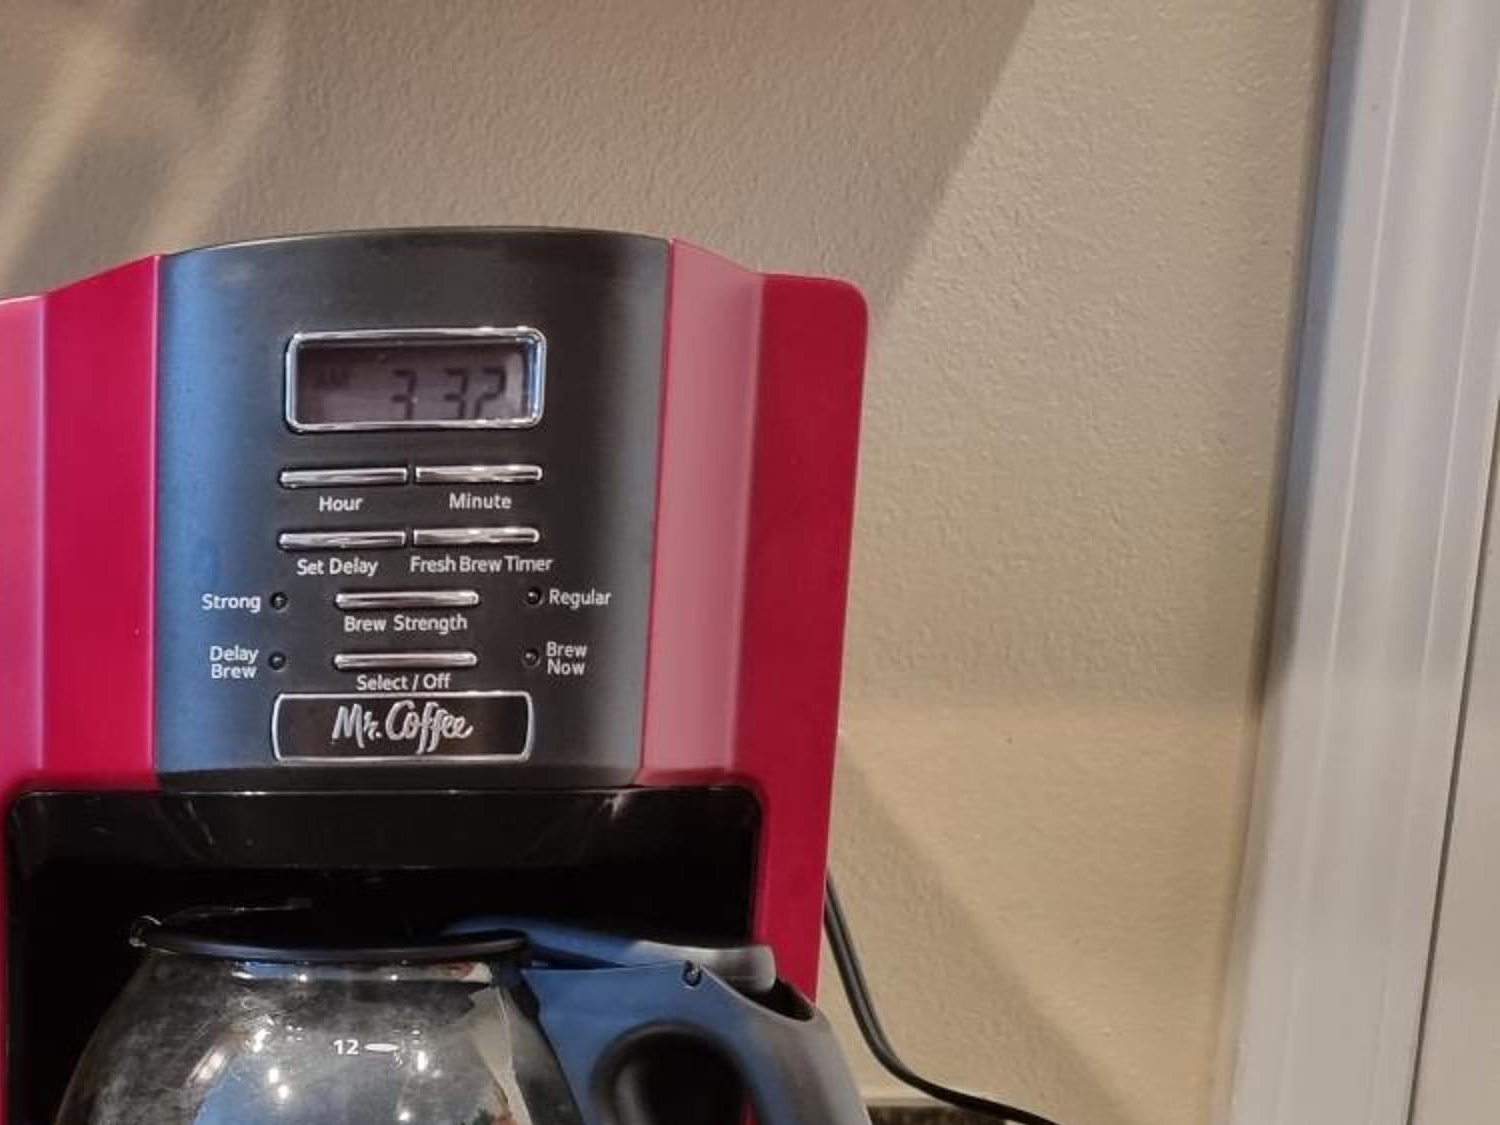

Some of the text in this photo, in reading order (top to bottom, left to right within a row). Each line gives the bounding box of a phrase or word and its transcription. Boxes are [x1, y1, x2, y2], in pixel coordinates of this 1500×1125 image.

[319, 496, 364, 512] Hour
[449, 492, 513, 510] Minute
[297, 557, 379, 577] Set Delay
[409, 554, 553, 573] Fresh Brew Timer
[201, 593, 261, 614] Strong
[548, 587, 613, 610] Regular
[343, 613, 469, 635] Brew Strength
[209, 644, 260, 665] Delay
[546, 641, 588, 658] Brew
[211, 663, 258, 679] Brew
[547, 658, 586, 675] Now
[356, 674, 408, 691] Select
[422, 672, 452, 690] Off
[331, 700, 474, 754] Mr. Coffee
[333, 1039, 359, 1055] 12
